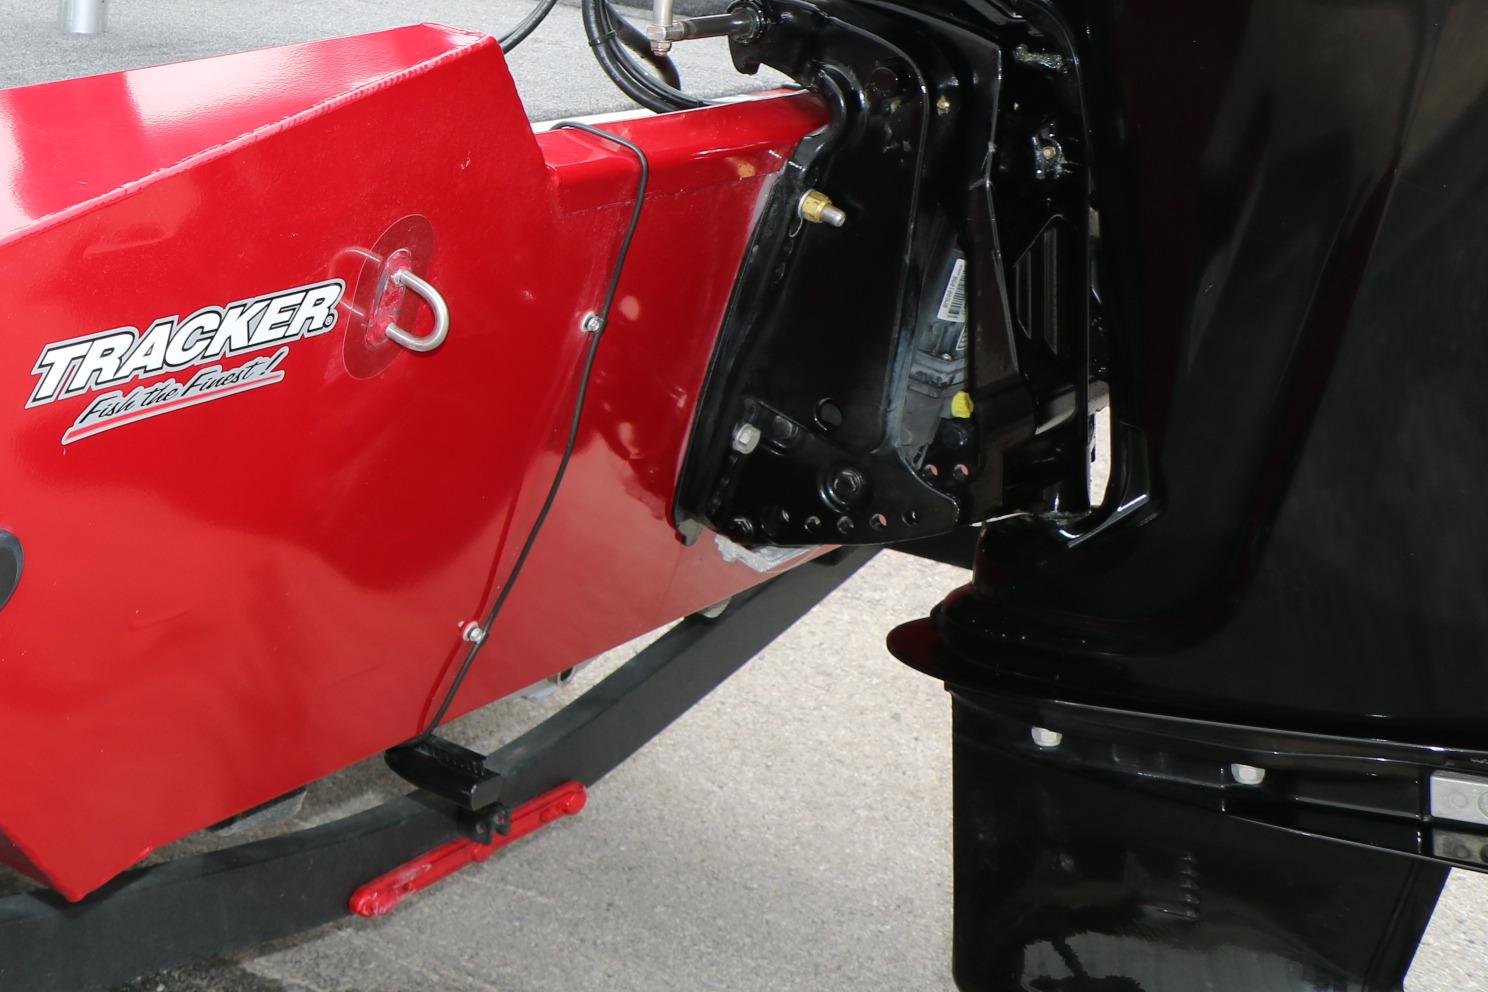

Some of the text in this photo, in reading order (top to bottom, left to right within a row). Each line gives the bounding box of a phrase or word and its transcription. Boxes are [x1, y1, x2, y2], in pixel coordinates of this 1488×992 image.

[30, 282, 342, 403] TRACKER
[79, 393, 136, 424] Fish
[142, 383, 179, 406] the
